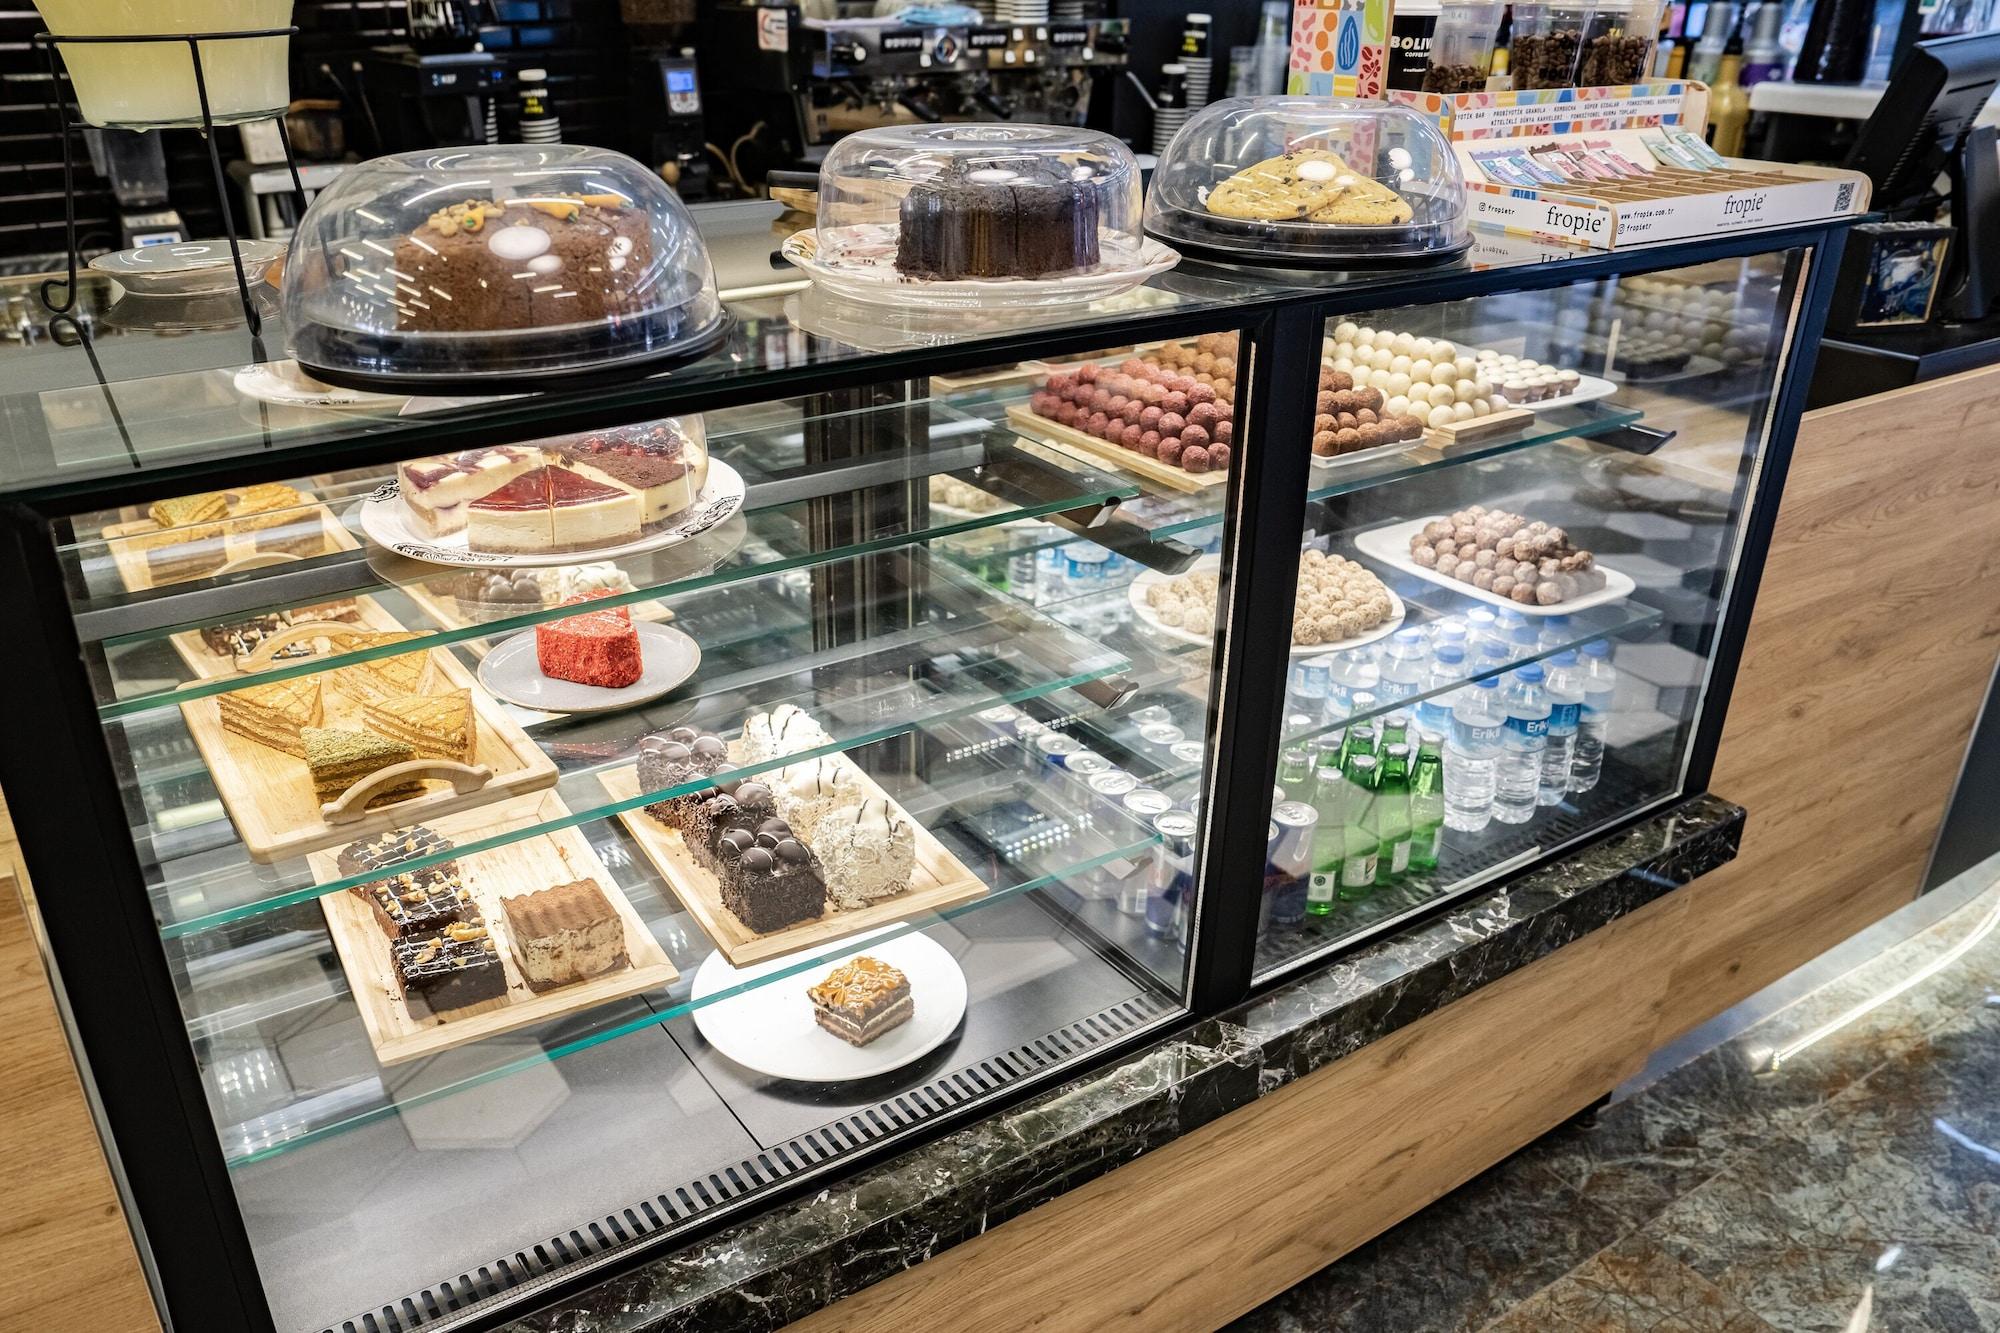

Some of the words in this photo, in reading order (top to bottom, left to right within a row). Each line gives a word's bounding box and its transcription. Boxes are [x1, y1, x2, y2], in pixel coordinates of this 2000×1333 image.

[1525, 107, 1546, 115] GRANOLA
[1487, 204, 1516, 216] fropietr
[1620, 207, 1675, 221] www.fropie.com.tr
[1545, 205, 1602, 236] fropie
[1626, 223, 1652, 233] fropietr
